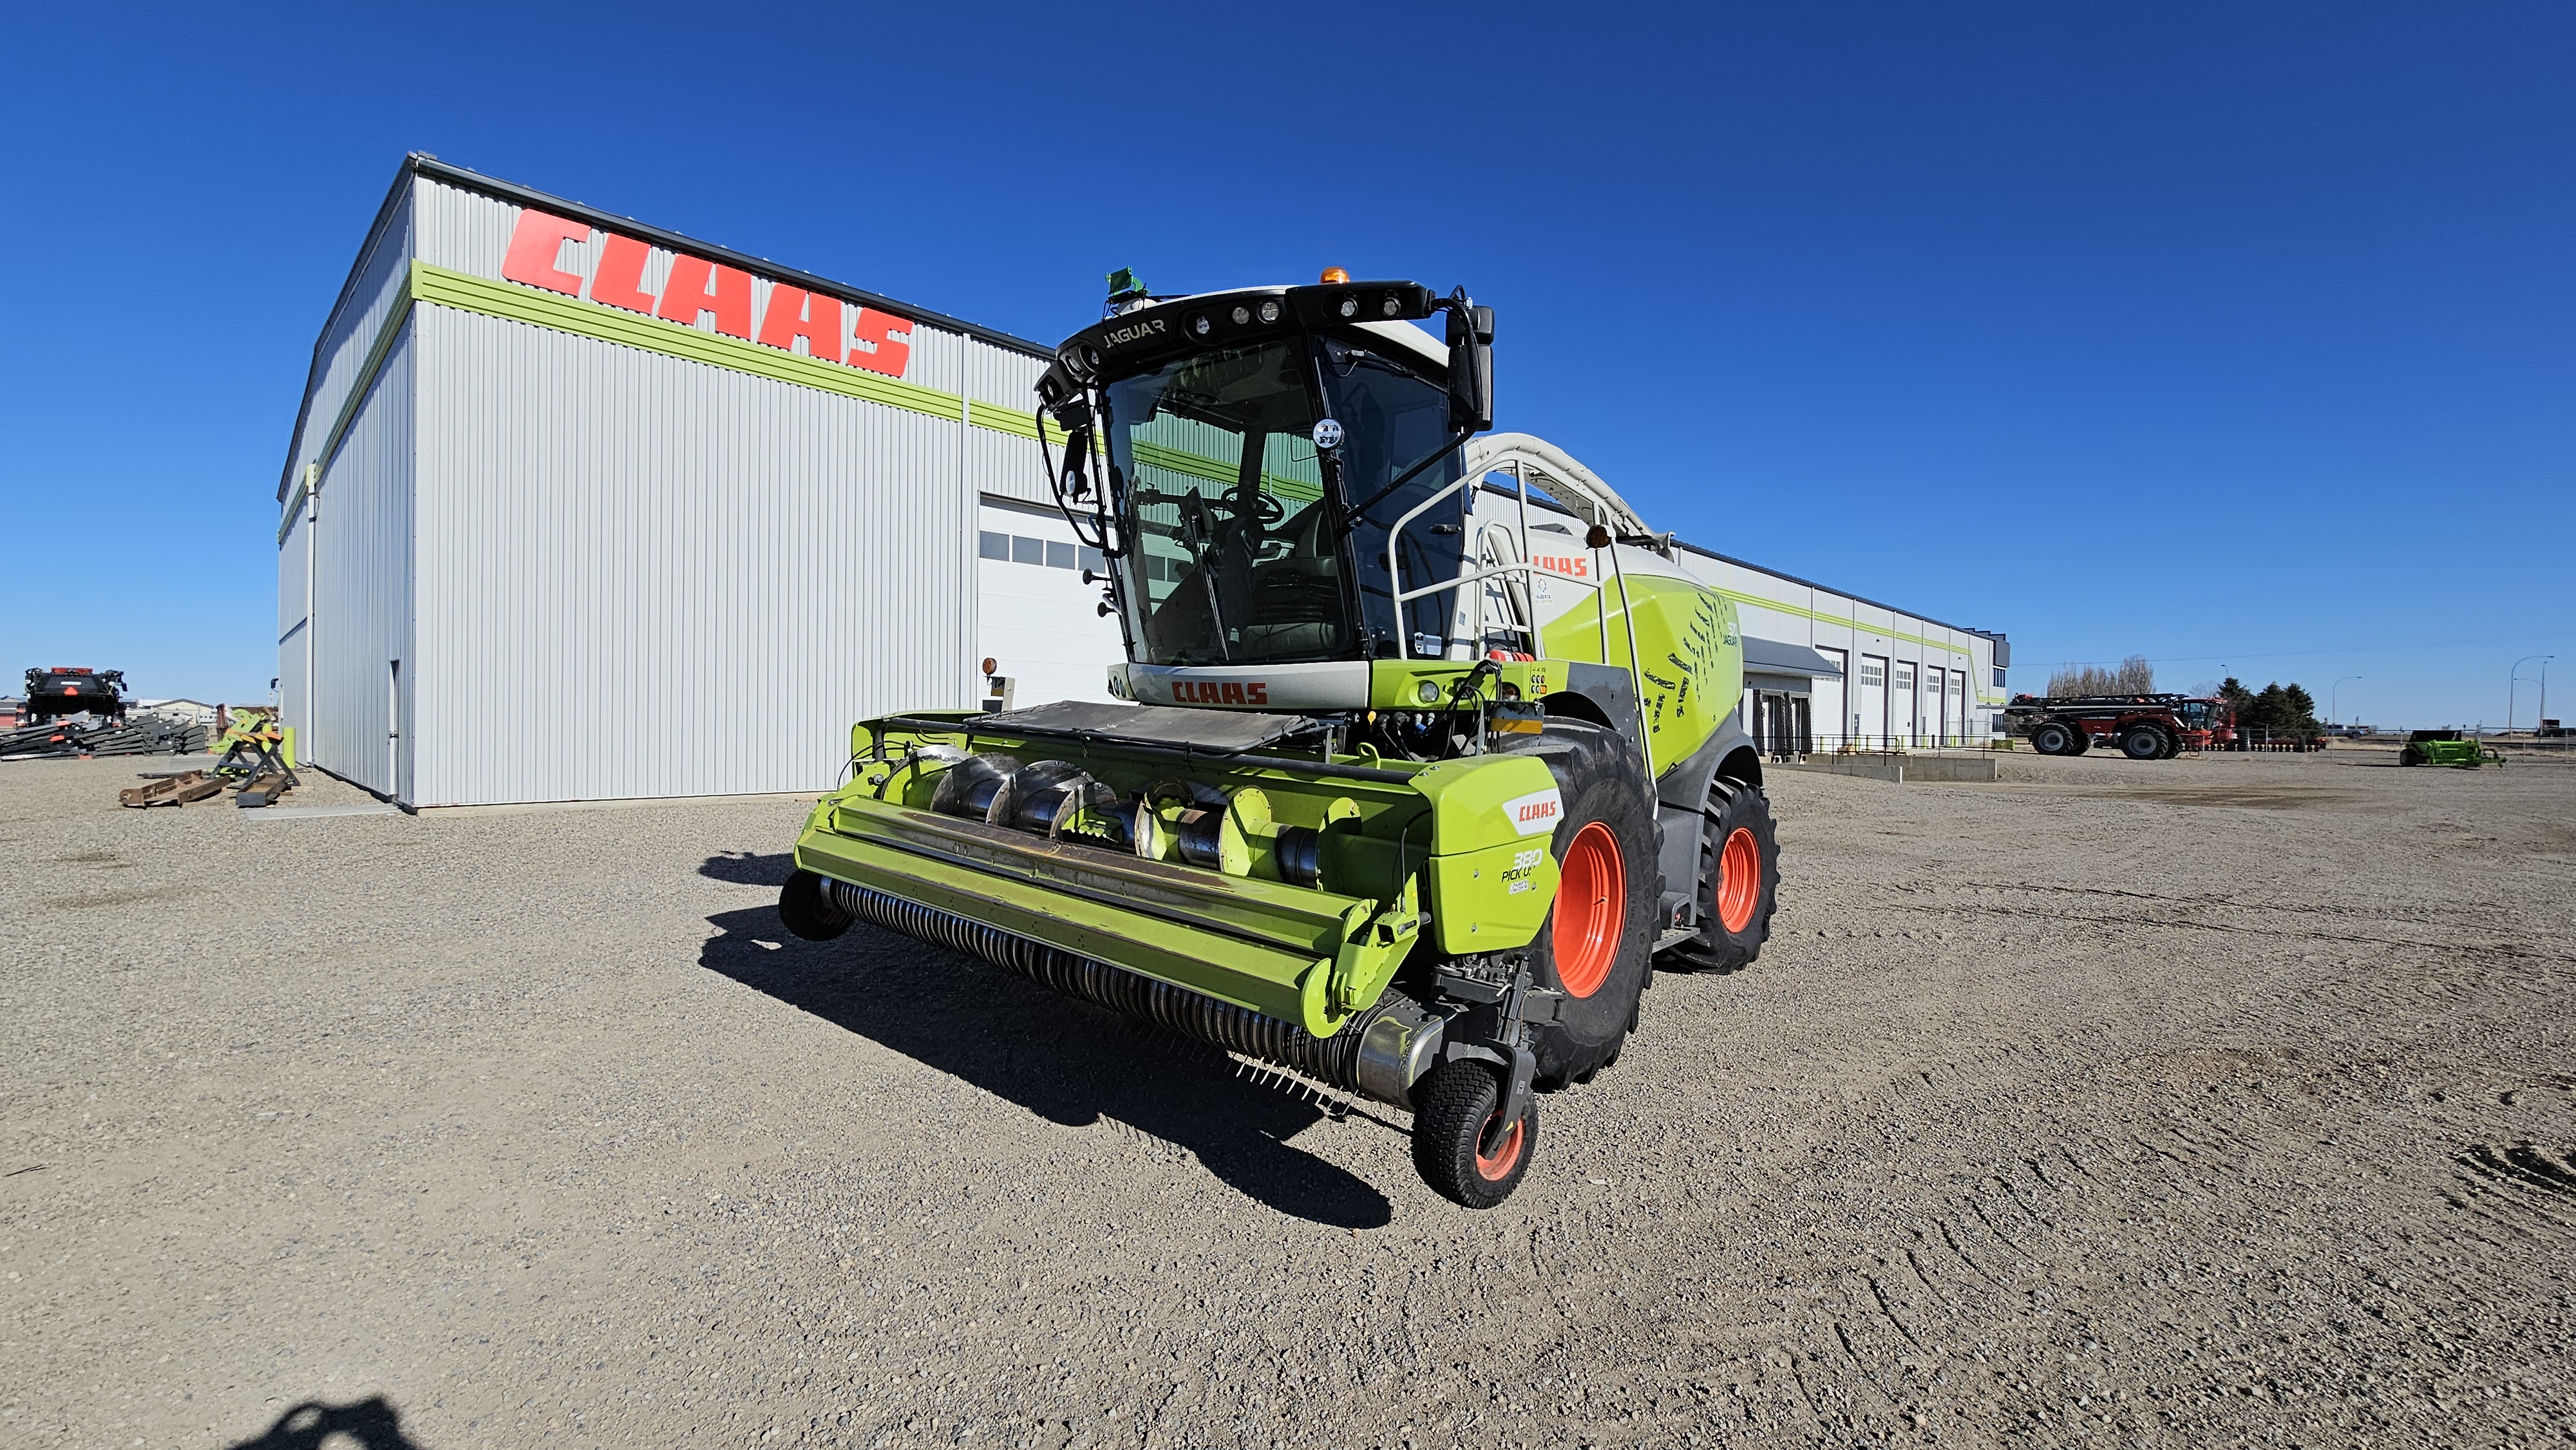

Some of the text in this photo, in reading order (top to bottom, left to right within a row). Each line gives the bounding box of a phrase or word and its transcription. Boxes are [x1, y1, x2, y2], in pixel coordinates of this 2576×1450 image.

[502, 209, 914, 377] CLAAS
[1104, 319, 1166, 348] JAGUAR
[1523, 556, 1587, 576] LAAS
[1723, 634, 1738, 646] JAGUAR
[1172, 682, 1267, 705] CLAAS
[1519, 801, 1556, 822] CLAAS
[1513, 848, 1542, 869] 380
[1501, 867, 1522, 883] PICK
